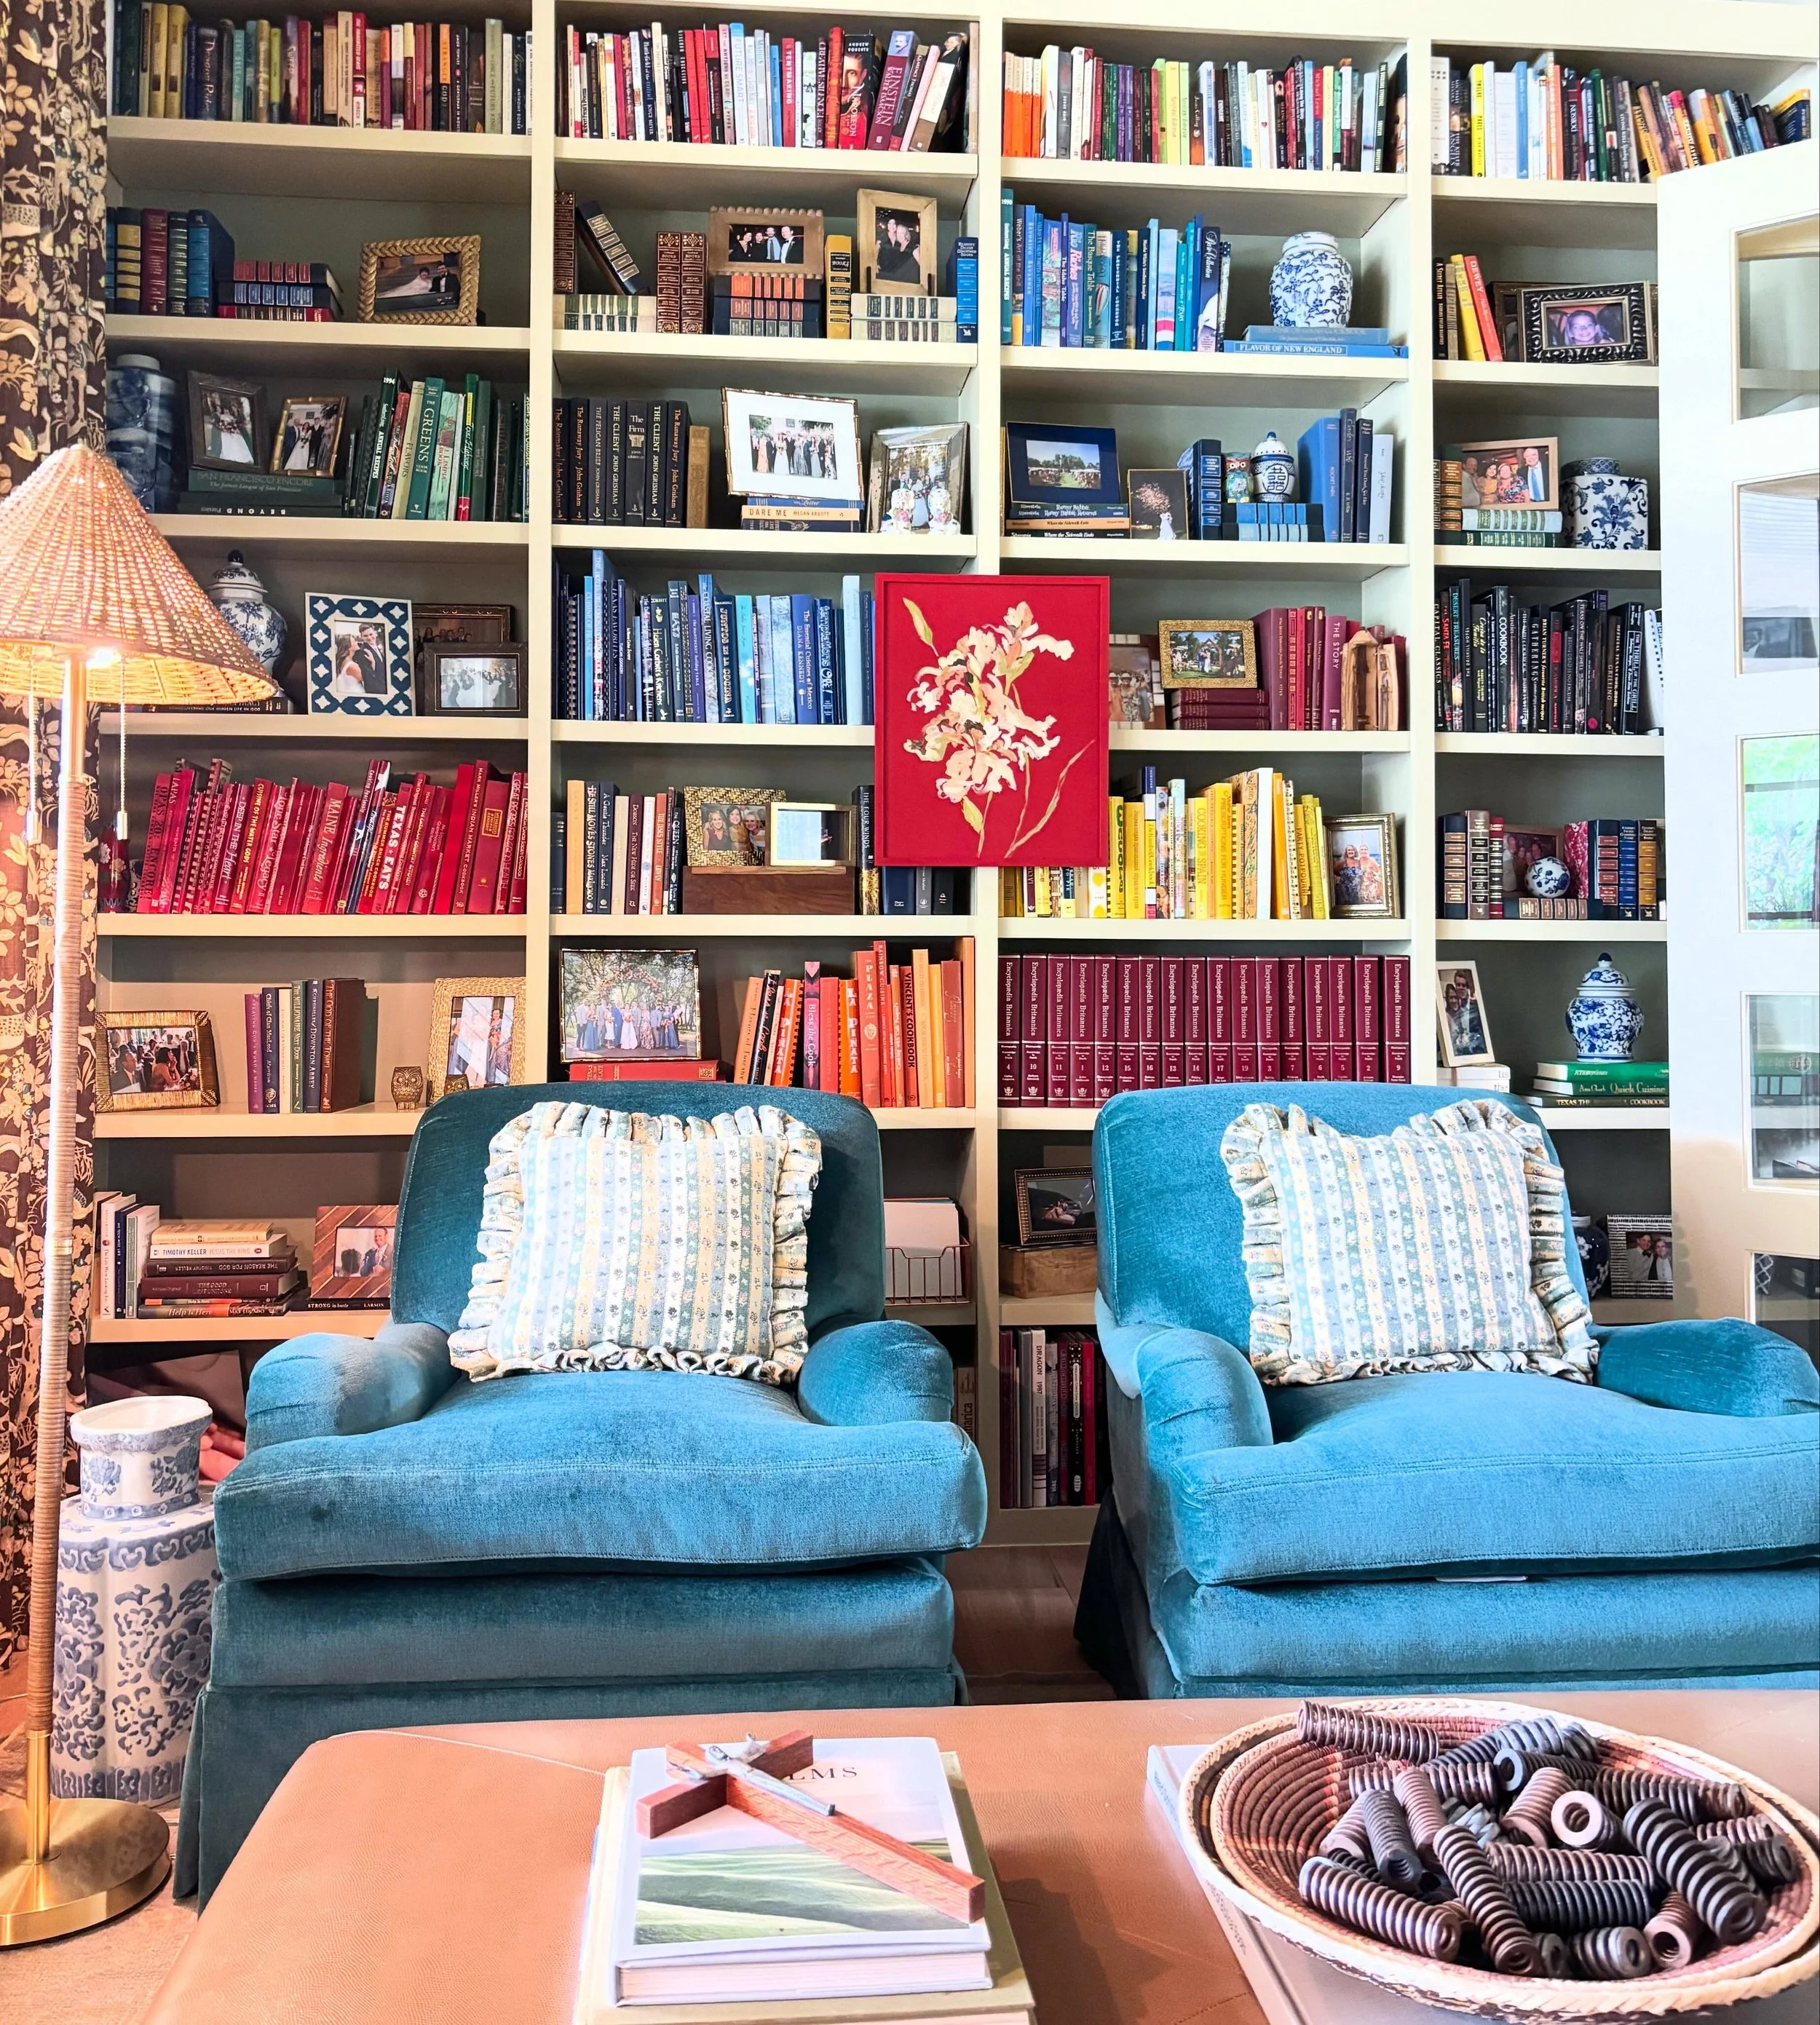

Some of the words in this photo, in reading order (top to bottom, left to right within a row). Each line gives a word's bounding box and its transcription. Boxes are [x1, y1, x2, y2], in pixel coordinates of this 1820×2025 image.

[735, 39, 743, 71] FUTURE
[736, 74, 744, 103] SMART
[882, 66, 893, 93] WALTER
[875, 95, 888, 123] ISAACSON
[882, 67, 903, 125] EINSTEIN
[848, 83, 864, 137] NAPOLEON
[1069, 230, 1081, 248] Rio
[1087, 231, 1095, 243] The
[1070, 250, 1082, 280] Riches
[1086, 245, 1094, 271] Basque
[1470, 261, 1484, 293] DEWEY
[1240, 344, 1271, 352] FLAVOR
[1272, 344, 1282, 352] OF
[1283, 345, 1301, 353] NEW
[1303, 345, 1342, 354] ENGLAND
[652, 405, 660, 421] THE
[374, 431, 384, 454] ANNUAL
[418, 408, 434, 461] GREENS
[574, 419, 583, 446] Runaway
[652, 423, 660, 452] CLIENT
[671, 421, 680, 448] Runaway
[372, 455, 382, 478] RECIPES
[401, 443, 413, 477] FLAVORS
[574, 448, 583, 460] Jury
[670, 449, 679, 461] Jury
[611, 473, 619, 504] GRISHAM
[651, 473, 659, 504] GRISHAM
[670, 469, 679, 483] John
[554, 480, 562, 507] Grisham
[670, 484, 678, 508] Grisham
[702, 591, 712, 624] COASTAL
[1452, 593, 1460, 618] DESERT
[654, 629, 662, 647] Helen
[704, 626, 713, 650] LIVING
[1441, 618, 1449, 641] SANTA
[1452, 622, 1460, 660] TREASURES
[1498, 617, 1508, 665] COOKBOOK
[1443, 641, 1449, 649] FE
[1530, 624, 1540, 682] GATHERINGS
[654, 649, 663, 676] Corbitt's
[705, 651, 714, 690] COOKBOOK
[1434, 646, 1442, 683] CLASSICS
[656, 678, 664, 705] Kitchens
[253, 783, 265, 804] CUISINE
[472, 784, 481, 807] MILLER'S
[250, 816, 258, 826] THE
[467, 809, 477, 830] INDIAN
[602, 800, 610, 819] Gentle
[245, 828, 256, 847] WATER
[388, 806, 405, 848] TEXAS
[601, 820, 609, 845] Thunder
[1197, 808, 1206, 849] COOKING
[242, 848, 252, 863] GODS
[312, 837, 333, 882] Ingredients
[462, 831, 475, 862] MARKET
[379, 857, 395, 890] EATS
[459, 864, 468, 894] COOKBOOK
[1197, 858, 1206, 884] SPAIN
[879, 978, 887, 1006] CUISINE
[904, 972, 914, 1016] VINCENT'S
[807, 1004, 817, 1026] Bless
[1101, 1004, 1109, 1037] Britannica
[1192, 1006, 1200, 1038] Britannica
[1265, 1006, 1273, 1039] Britannica
[1394, 1005, 1402, 1037] Britannica
[308, 1029, 317, 1064] DOWNTON
[807, 1028, 816, 1041] the
[906, 1018, 915, 1068] COOKBOOK
[807, 1042, 816, 1066] Cook
[308, 1066, 316, 1088] ABBEY
[1035, 1345, 1043, 1375] DRAGON
